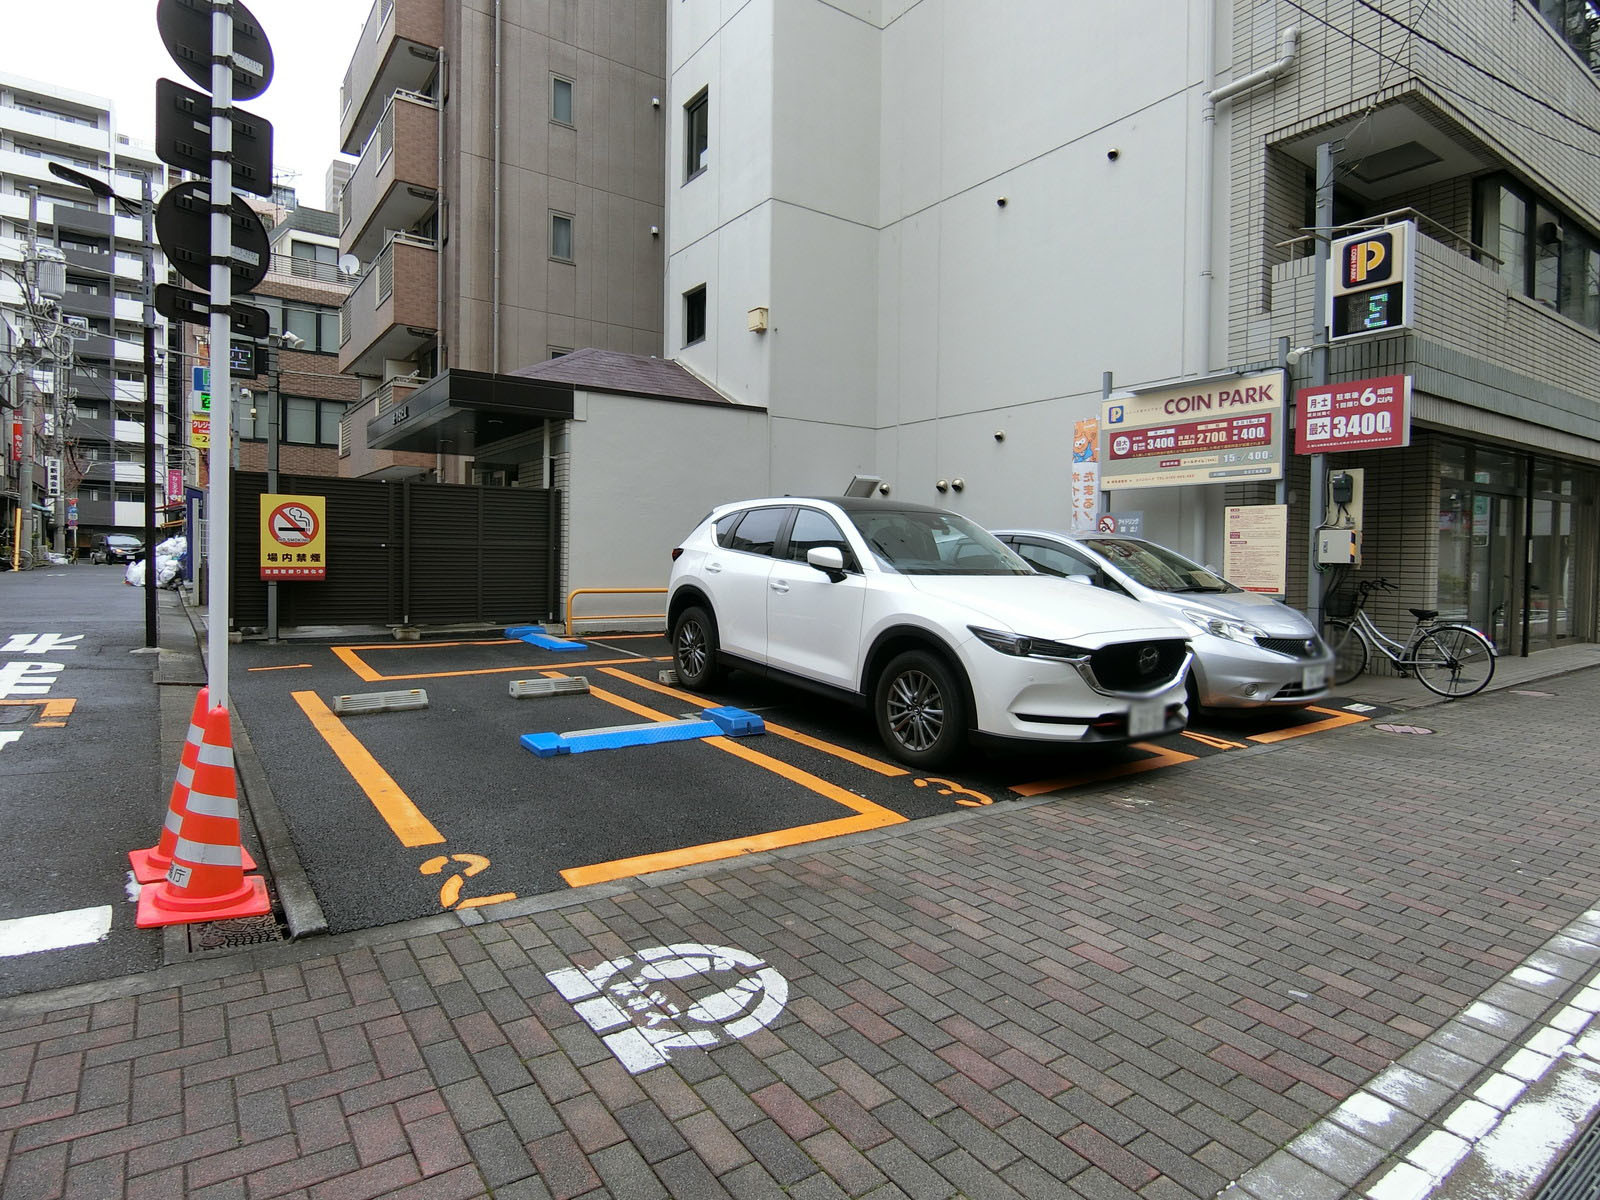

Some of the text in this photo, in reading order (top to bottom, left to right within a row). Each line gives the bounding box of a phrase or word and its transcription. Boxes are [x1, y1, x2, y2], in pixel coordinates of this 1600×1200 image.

[1164, 393, 1212, 415] COIN
[1218, 384, 1274, 408] PARK
[1360, 387, 1377, 407] 6
[1309, 422, 1329, 436] 最大
[267, 552, 321, 563] 場内禁煙
[913, 777, 993, 807] 3
[419, 853, 517, 910] 2
